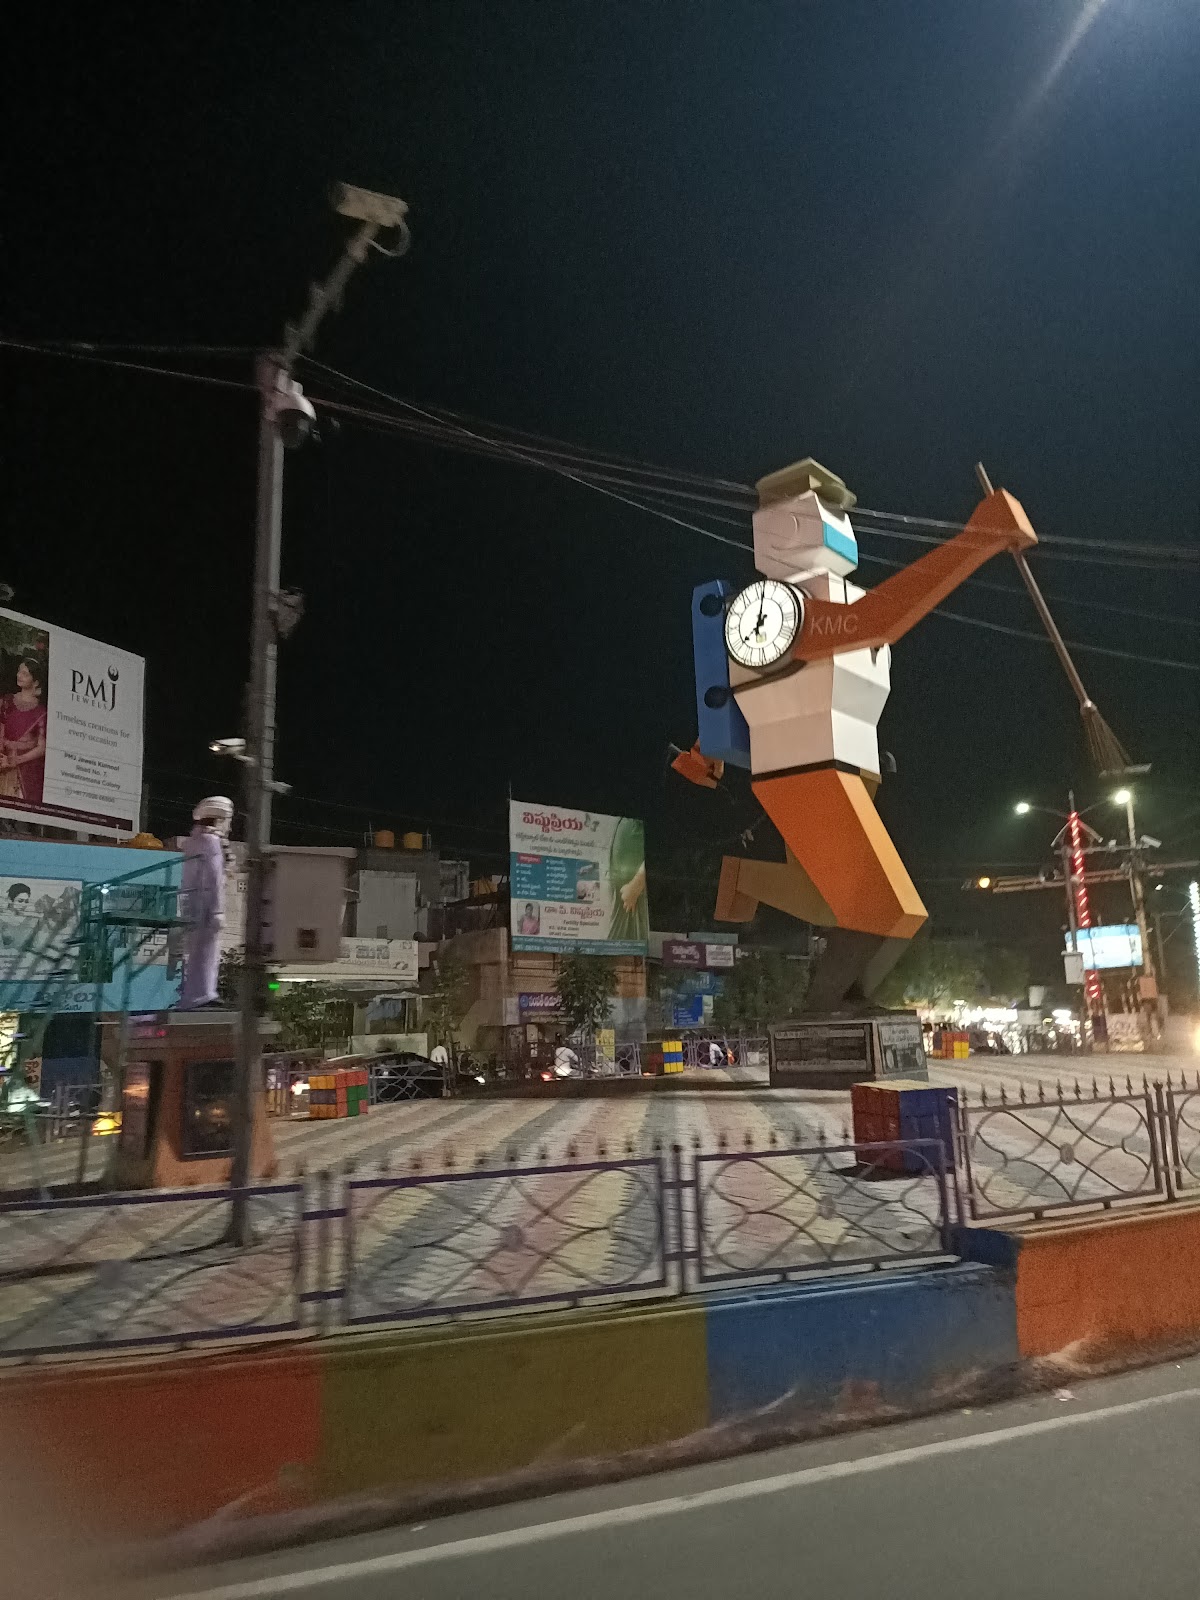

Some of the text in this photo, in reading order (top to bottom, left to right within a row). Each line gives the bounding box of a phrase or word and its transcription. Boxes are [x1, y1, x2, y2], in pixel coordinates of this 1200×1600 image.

[810, 613, 858, 635] KMC
[69, 668, 117, 711] PMJ
[71, 693, 107, 710] JEWELS
[56, 710, 86, 726] Timeless
[88, 722, 119, 736] creations
[68, 728, 118, 747] every occasion
[522, 811, 584, 833] విష్ణుప్రియ
